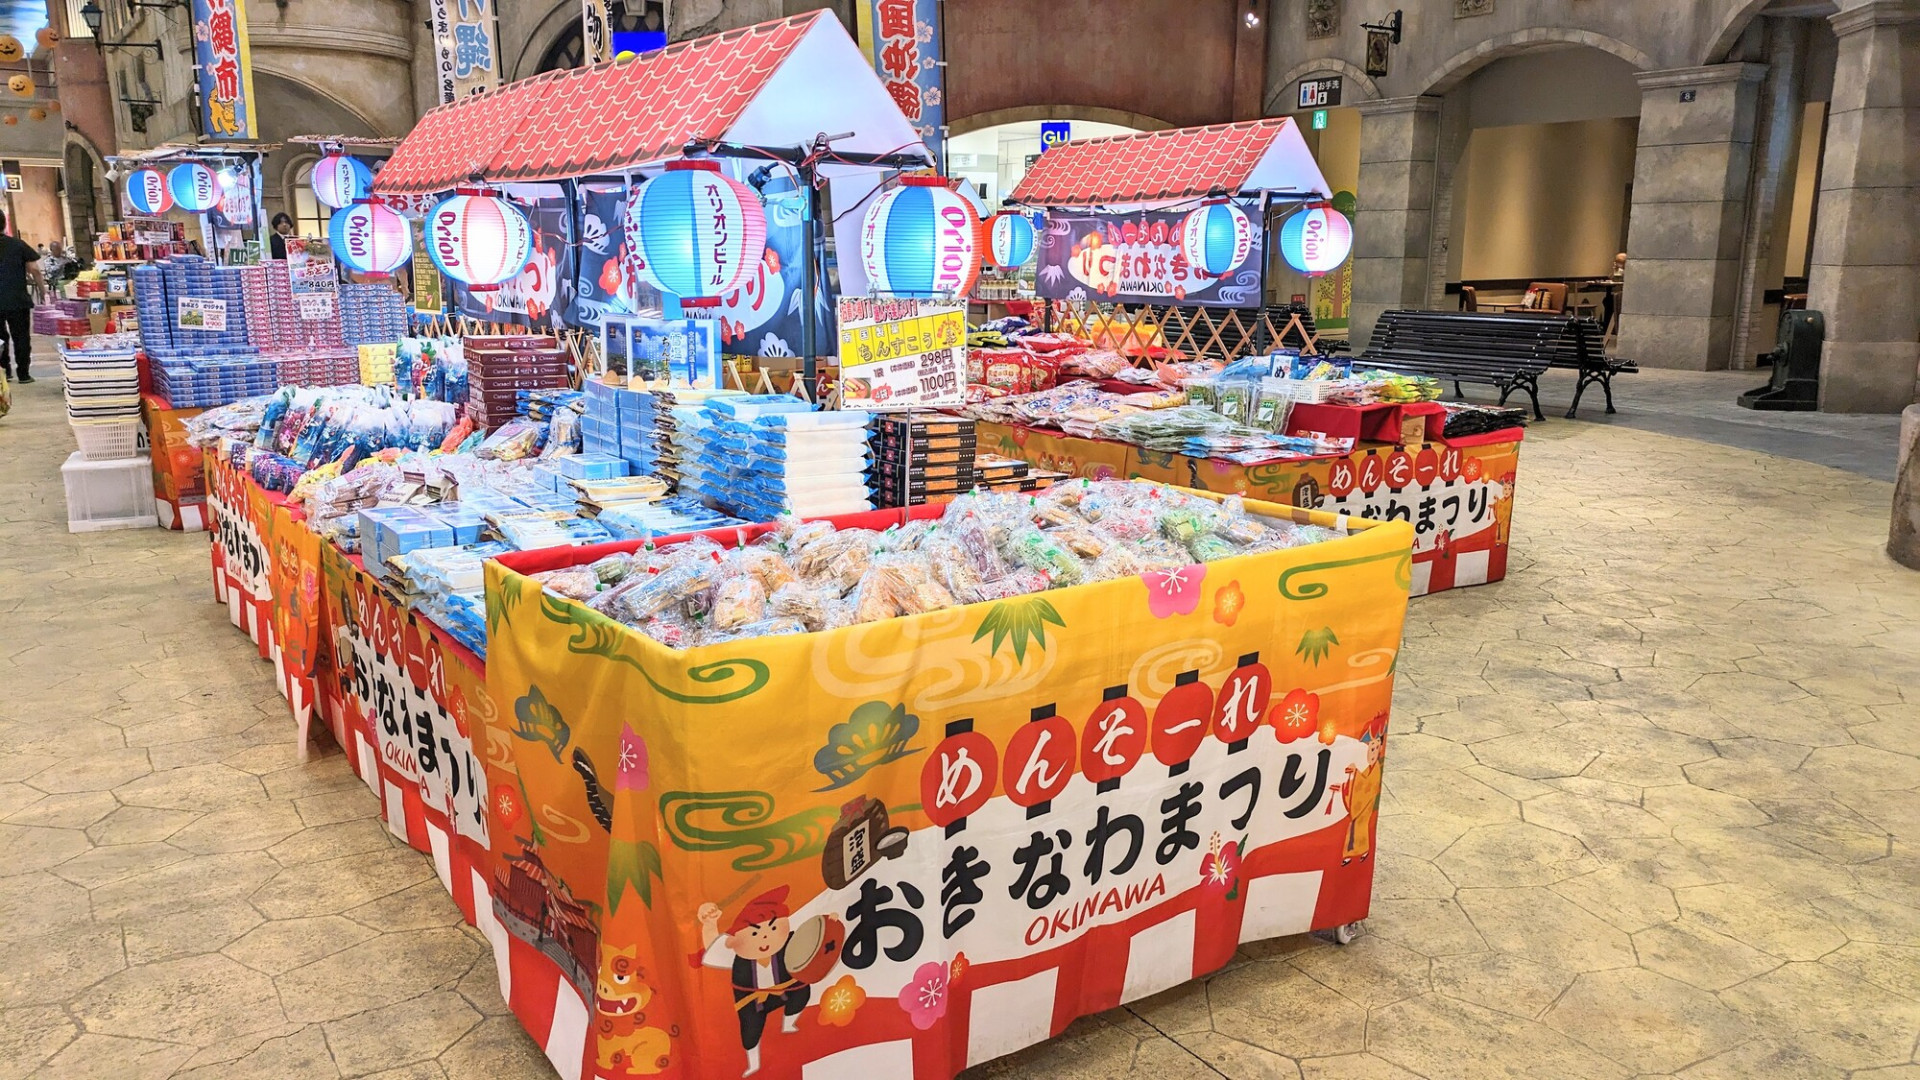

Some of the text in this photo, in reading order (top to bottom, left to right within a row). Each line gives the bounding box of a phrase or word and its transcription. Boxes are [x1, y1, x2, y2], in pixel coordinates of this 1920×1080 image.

[207, 0, 238, 100] 縄市
[1318, 80, 1340, 91] お手洗
[1043, 130, 1068, 145] GU
[146, 176, 162, 204] Orion
[196, 171, 211, 201] Orion
[341, 164, 350, 205] オリオンビール
[349, 215, 369, 257] Orion
[437, 211, 460, 267] Orion
[704, 184, 728, 286] オリオンビール
[865, 193, 892, 278] オリオンビ
[937, 206, 972, 289] Orion
[998, 215, 1008, 264] オリオンビール
[1189, 209, 1205, 269] オリオンビール
[1234, 216, 1252, 264] Orion
[1305, 219, 1325, 261] Orion
[308, 280, 335, 288] 840円
[858, 332, 933, 361] ちんすこう
[920, 348, 954, 368] 298円
[919, 371, 957, 393] 1100円
[1331, 450, 1460, 490] めんそーれ
[1338, 486, 1488, 535] わまつり
[355, 589, 447, 697] めんそーれ
[354, 647, 482, 826] おなわまつり
[935, 675, 1259, 809] めんそーれ
[385, 739, 431, 799] OKINA
[840, 748, 1332, 970] おきなわまつり
[849, 827, 866, 876] 泡盛
[1024, 873, 1167, 947] OKINAWA
